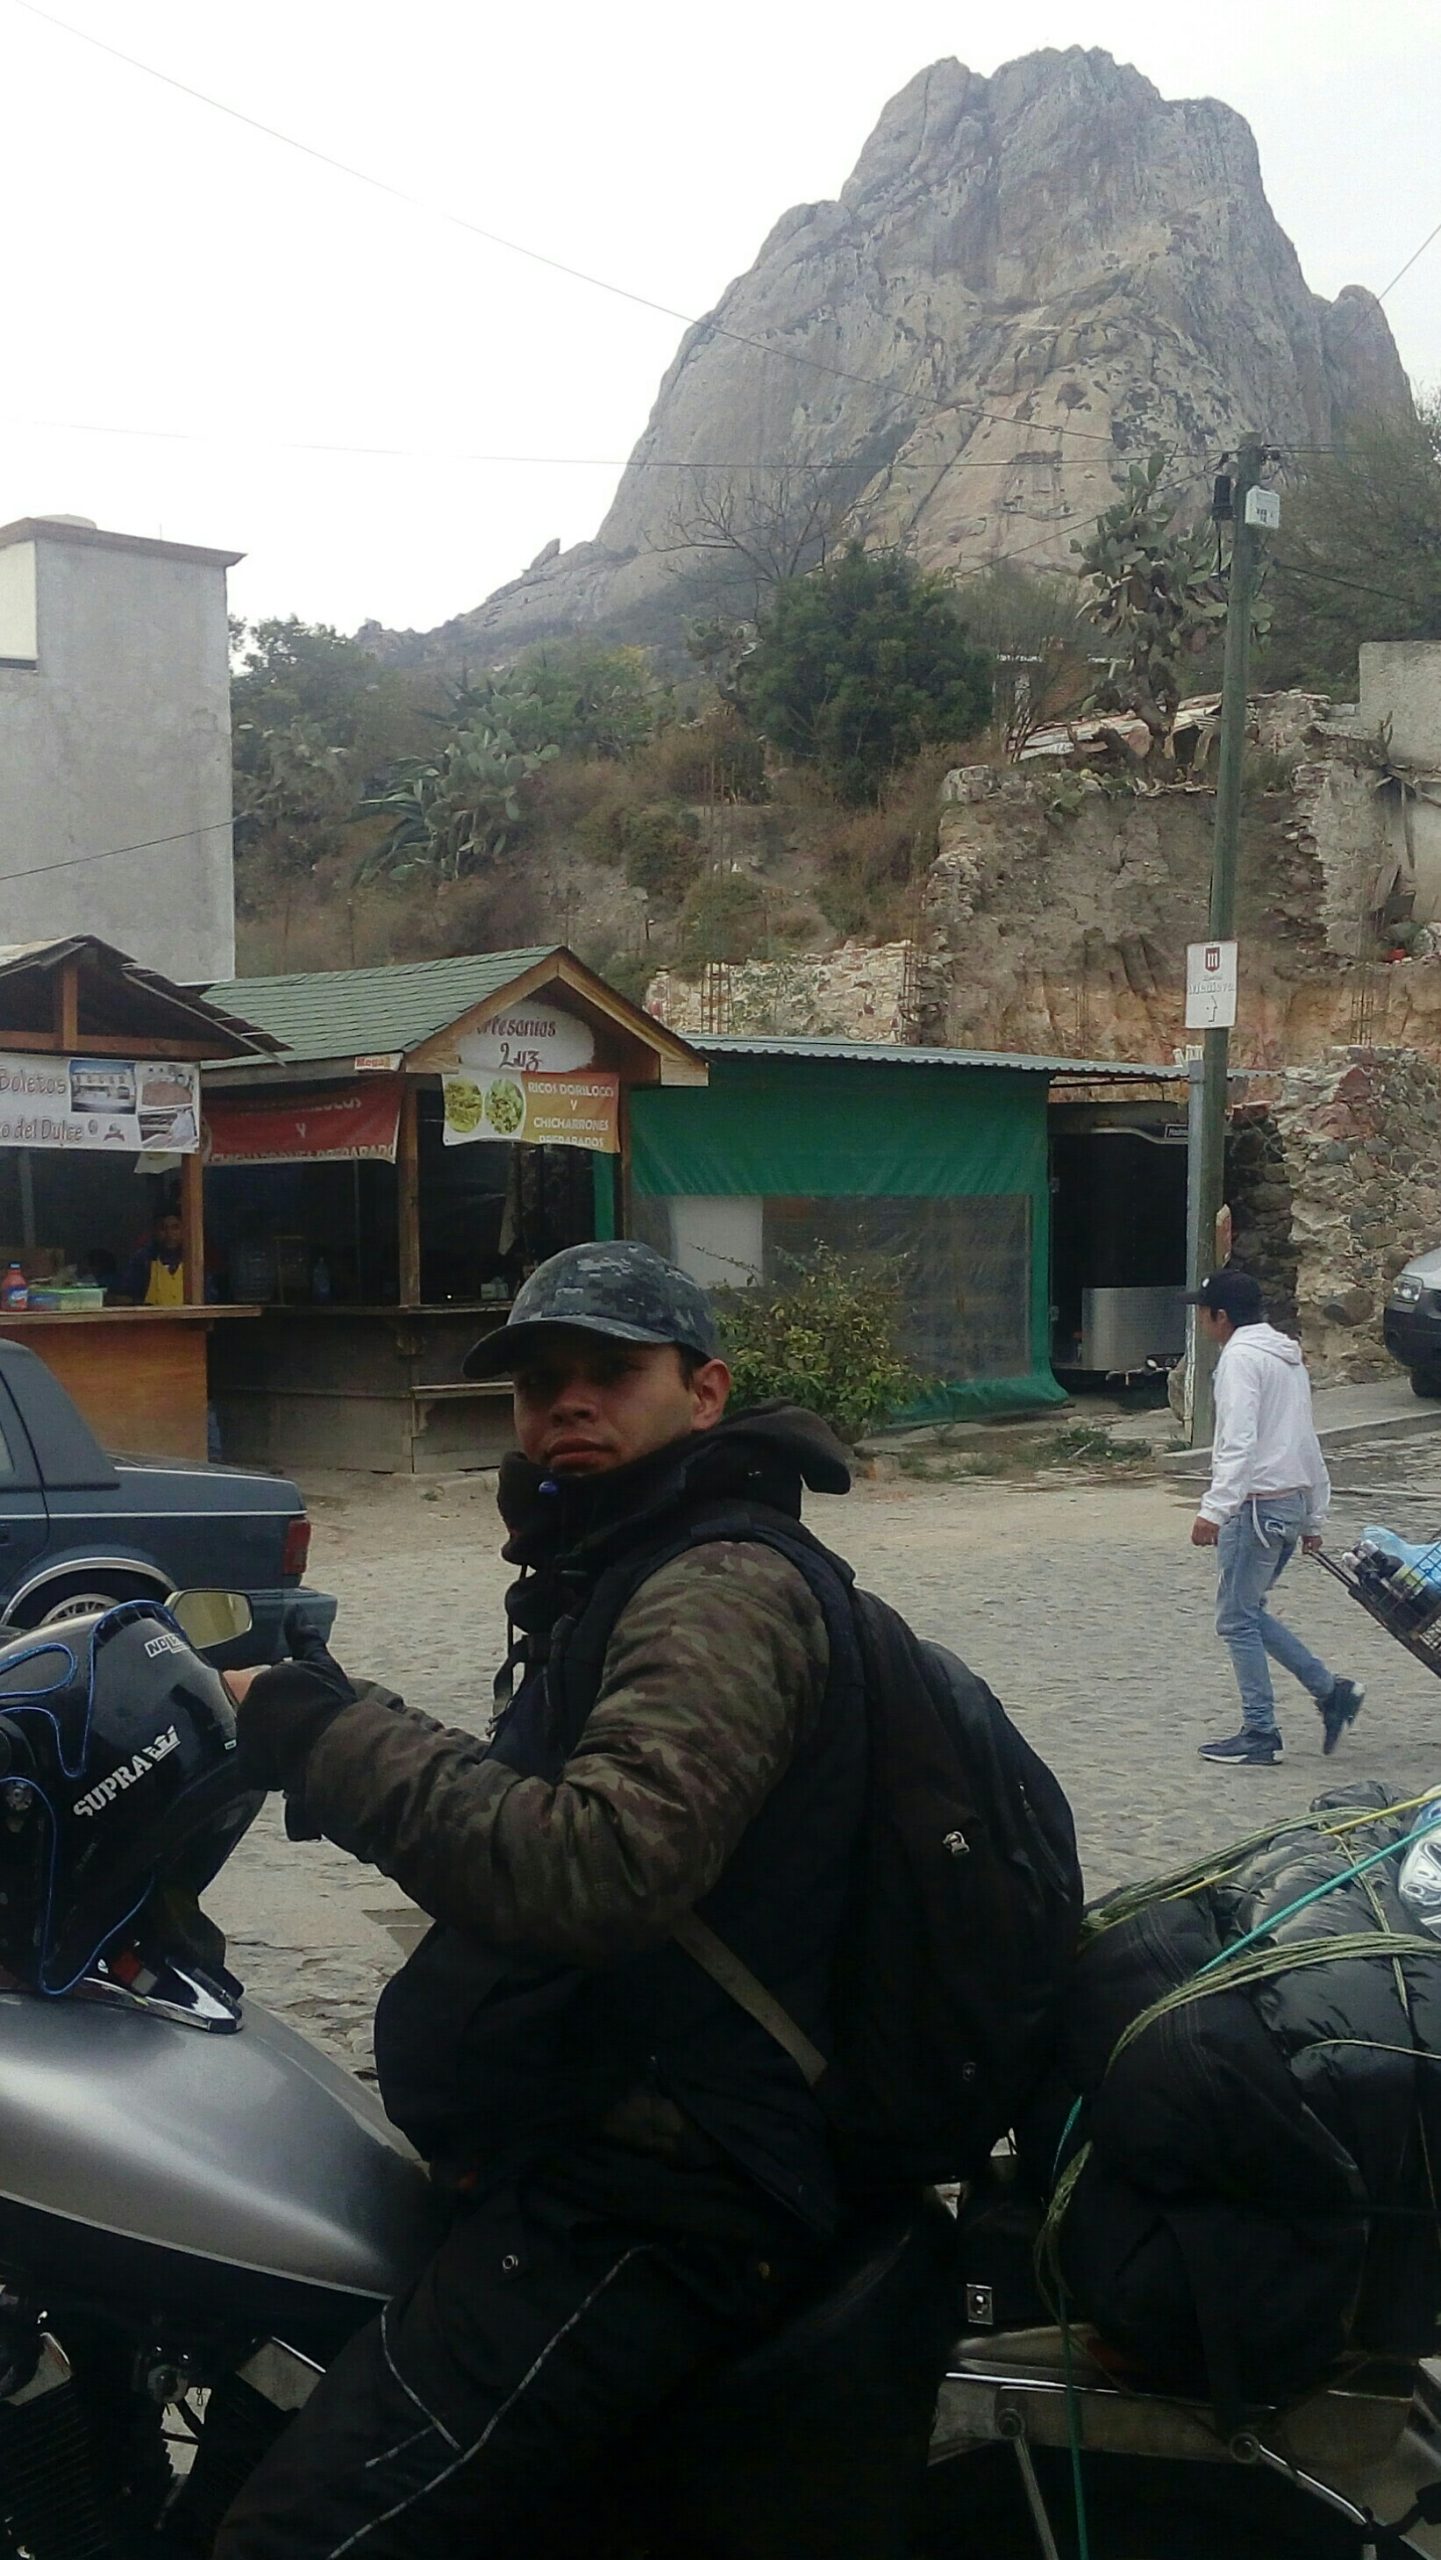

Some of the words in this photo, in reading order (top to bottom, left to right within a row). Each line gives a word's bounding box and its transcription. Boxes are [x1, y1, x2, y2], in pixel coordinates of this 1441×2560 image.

[0, 1068, 66, 1095] Boletos
[528, 1081, 557, 1094] RICOS
[14, 1119, 38, 1139] del
[41, 1118, 83, 1141] Dulce
[73, 1755, 153, 1816] SUPRA
